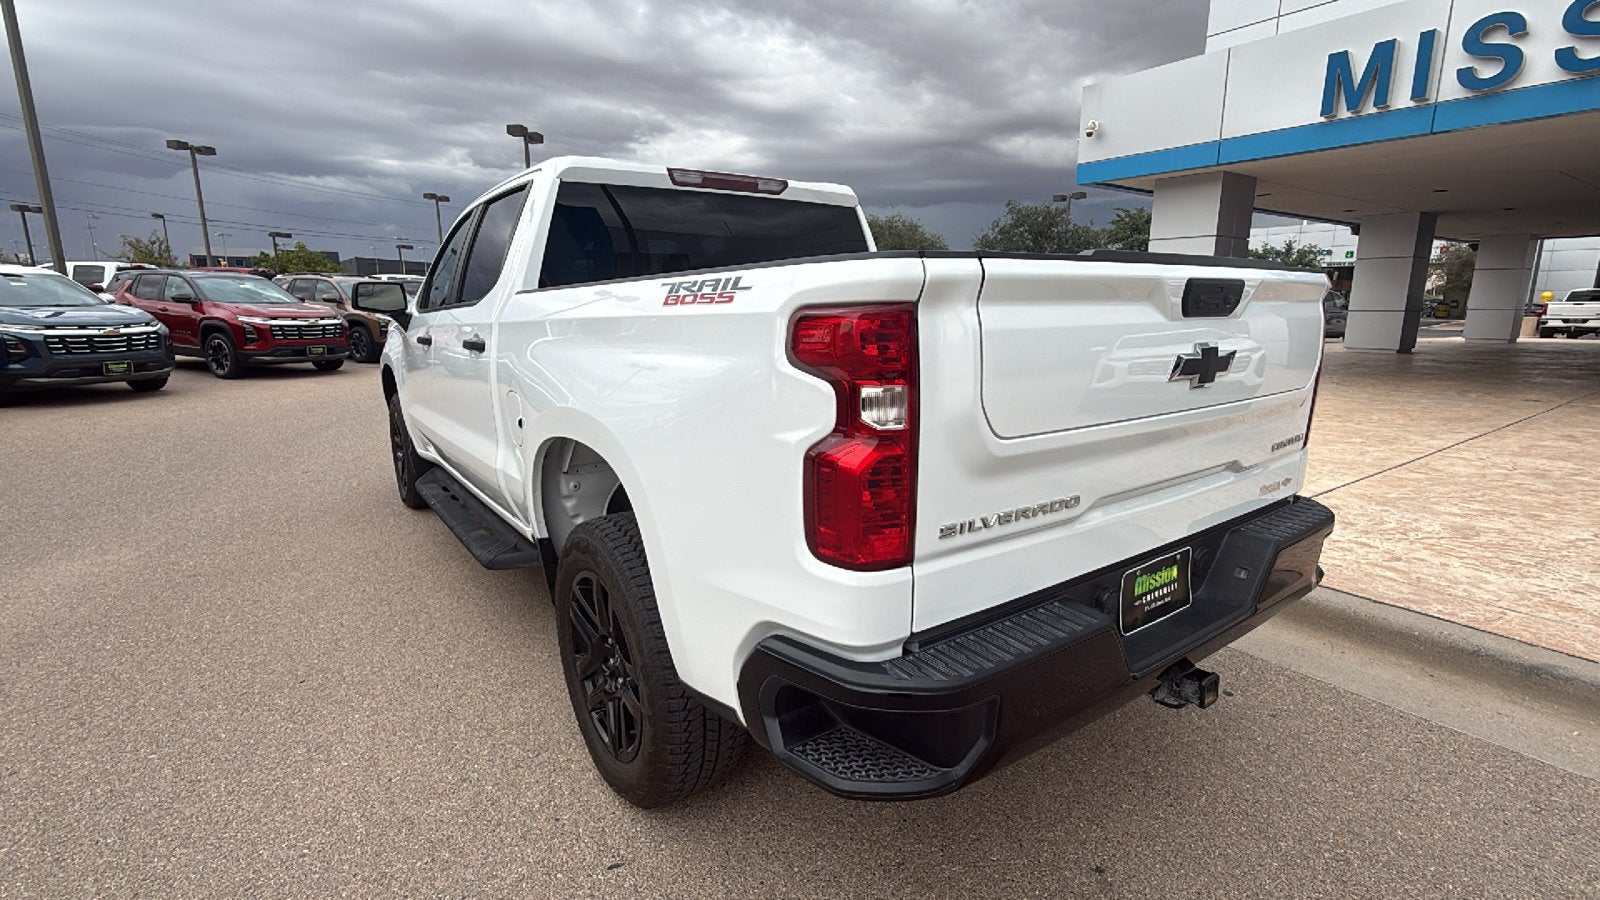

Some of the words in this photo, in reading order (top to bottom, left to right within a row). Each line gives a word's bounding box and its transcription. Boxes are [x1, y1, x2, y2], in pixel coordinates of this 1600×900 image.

[661, 276, 752, 294] TRAIL
[662, 292, 737, 306] BOSS
[938, 494, 1081, 539] SILVERADO
